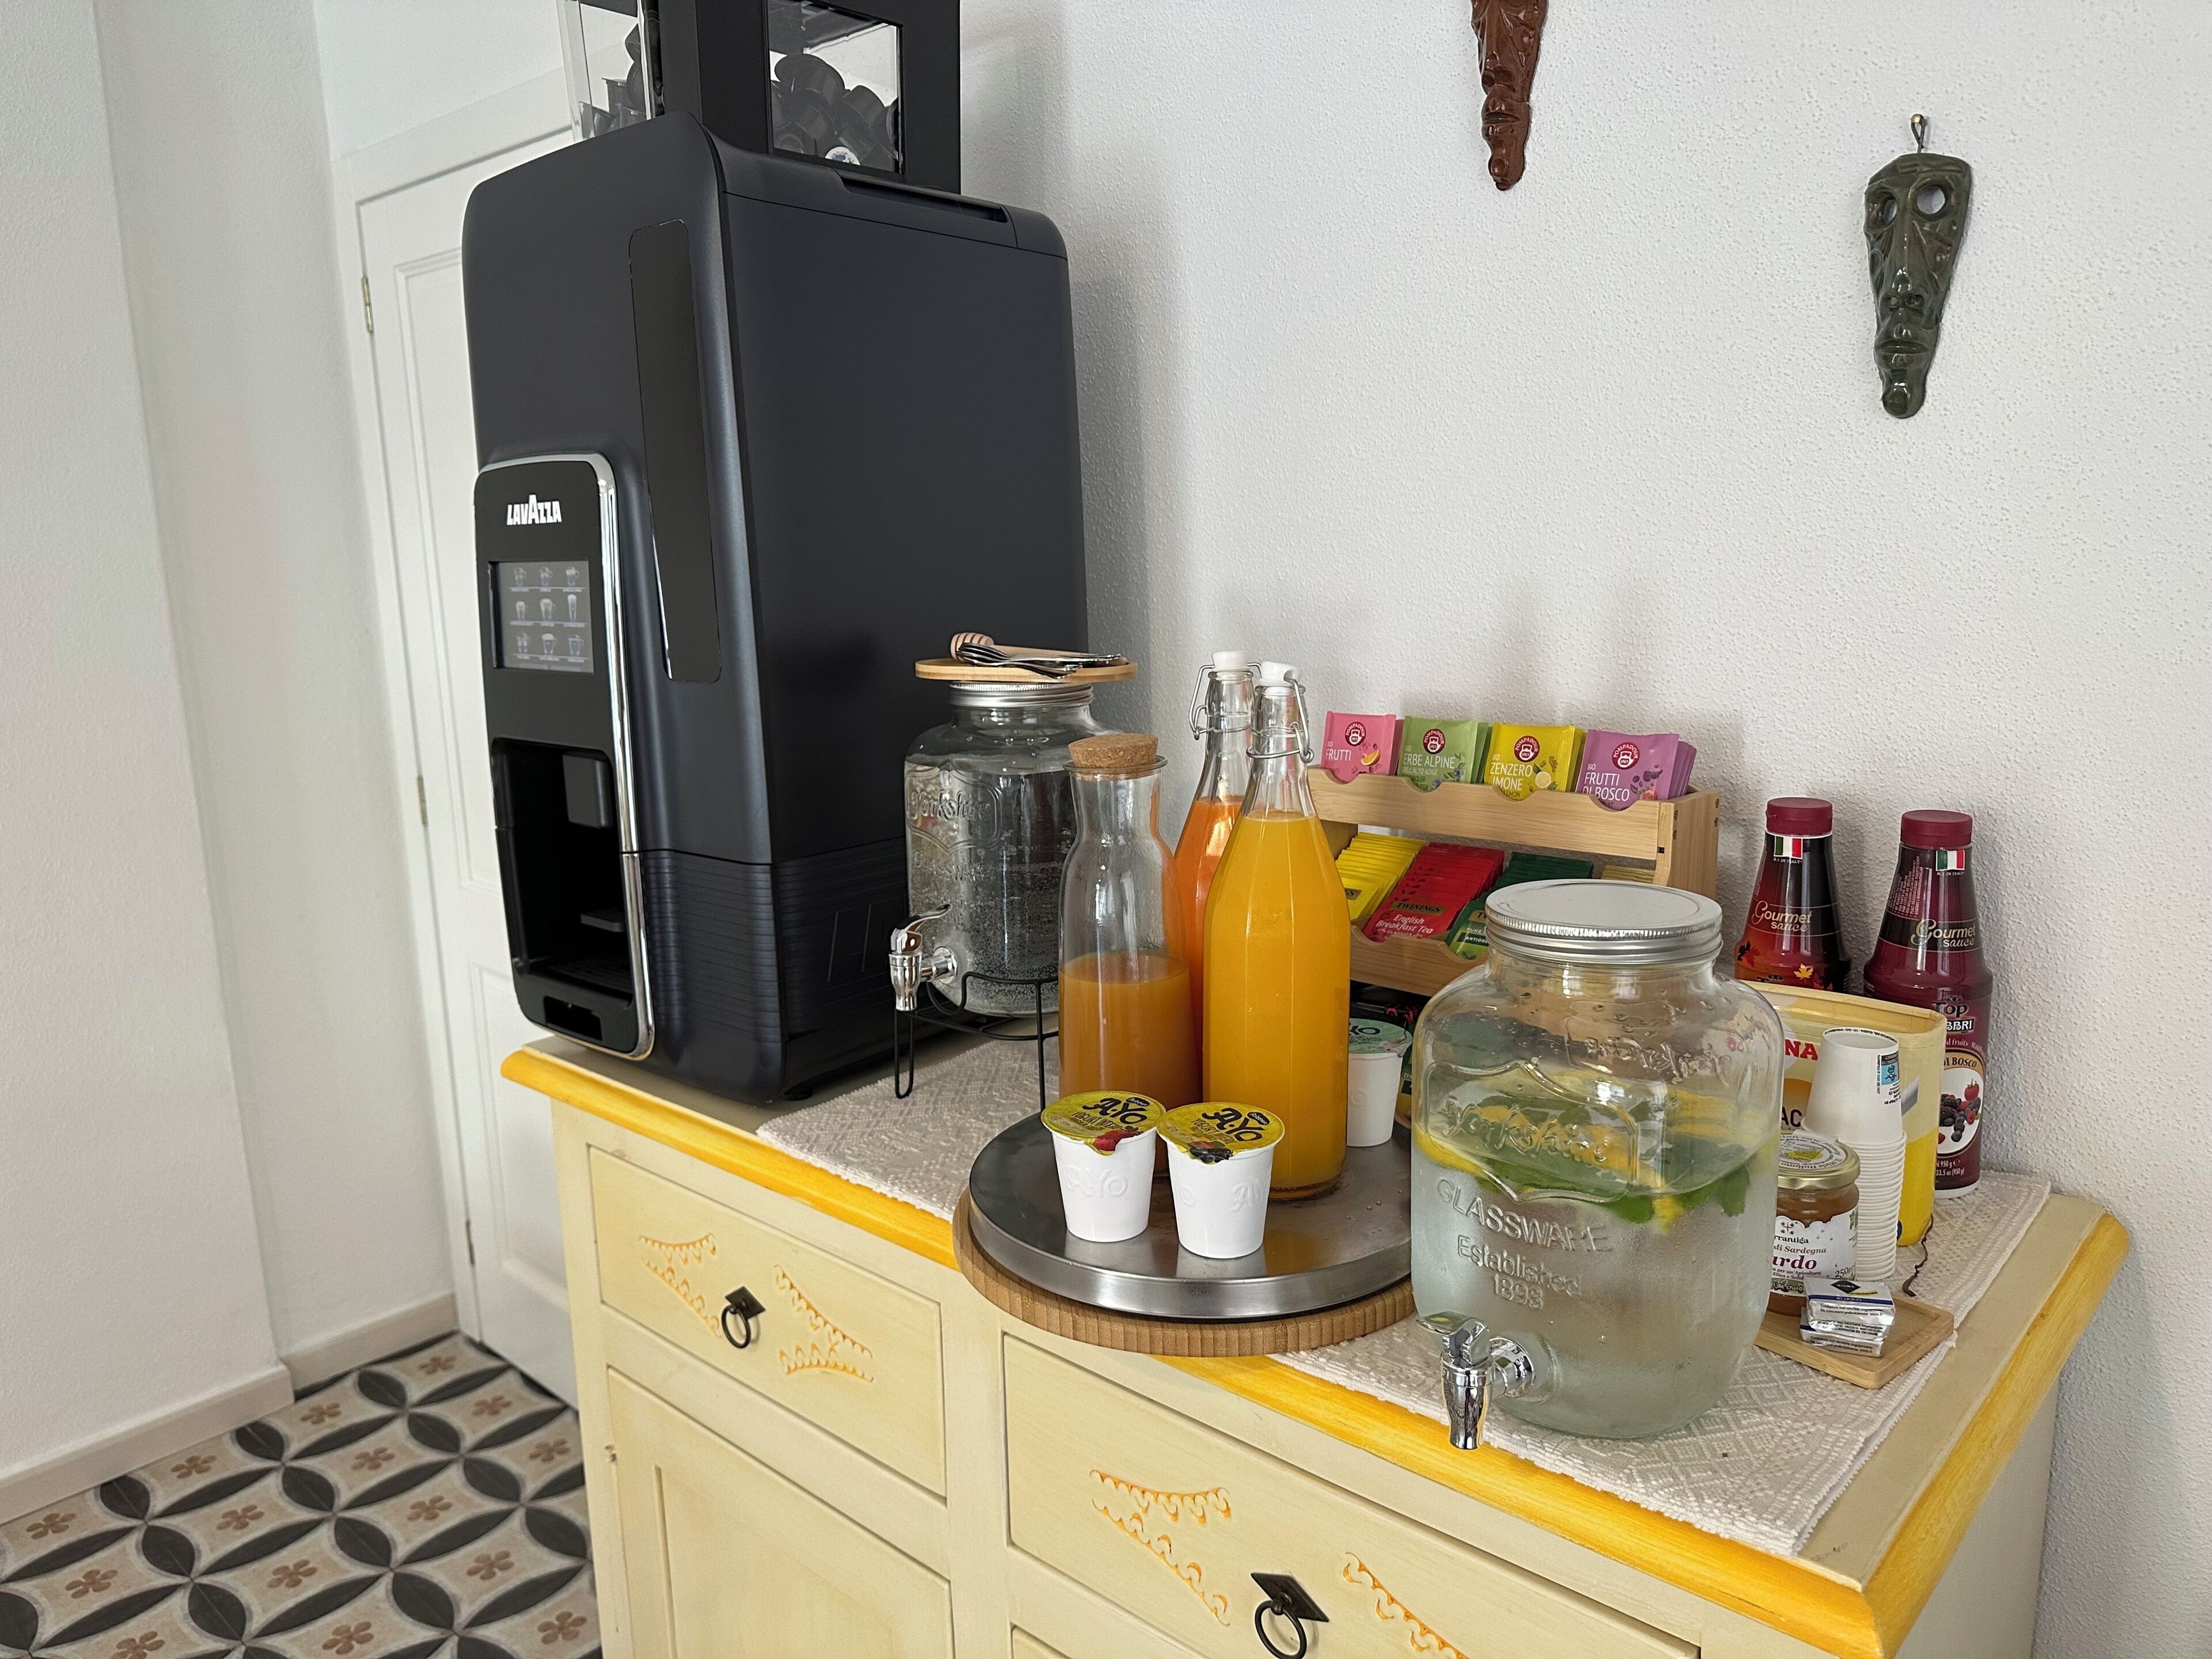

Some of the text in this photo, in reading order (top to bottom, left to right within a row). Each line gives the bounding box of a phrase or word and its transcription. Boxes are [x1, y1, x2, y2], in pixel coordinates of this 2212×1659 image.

[506, 494, 562, 525] LAVAZZA
[1346, 723, 1365, 737] POMPADOUR
[1423, 730, 1445, 745] POMPADOUR
[1515, 737, 1538, 752] POMPADOUR
[1325, 749, 1351, 761] FRUTTI
[1613, 744, 1638, 759] POMPADOUR
[1403, 753, 1456, 769] ERBE ALPINE
[1490, 763, 1533, 777] ZENZERO
[1493, 777, 1524, 790] IMONE
[1584, 772, 1620, 786] FRUTTI
[1595, 787, 1630, 801] BOSCO
[1396, 902, 1441, 913] TWININGS
[1751, 900, 1813, 925] Gourmet
[1393, 914, 1425, 925] English
[1375, 921, 1434, 934] Breakfast Tea
[1771, 922, 1808, 932] sauce
[1910, 919, 1976, 945] Gourmet
[1943, 938, 1975, 948] sauce
[1931, 1002, 1968, 1018] Top
[1947, 1020, 1972, 1031] BBRI
[1785, 1039, 1819, 1060] NA
[1952, 1056, 1977, 1068] BOSCO
[1774, 1235, 1809, 1244] rrantiga
[1784, 1245, 1826, 1255] Sardegna
[1458, 1234, 1582, 1297] Established
[1493, 1272, 1544, 1309] 1898
